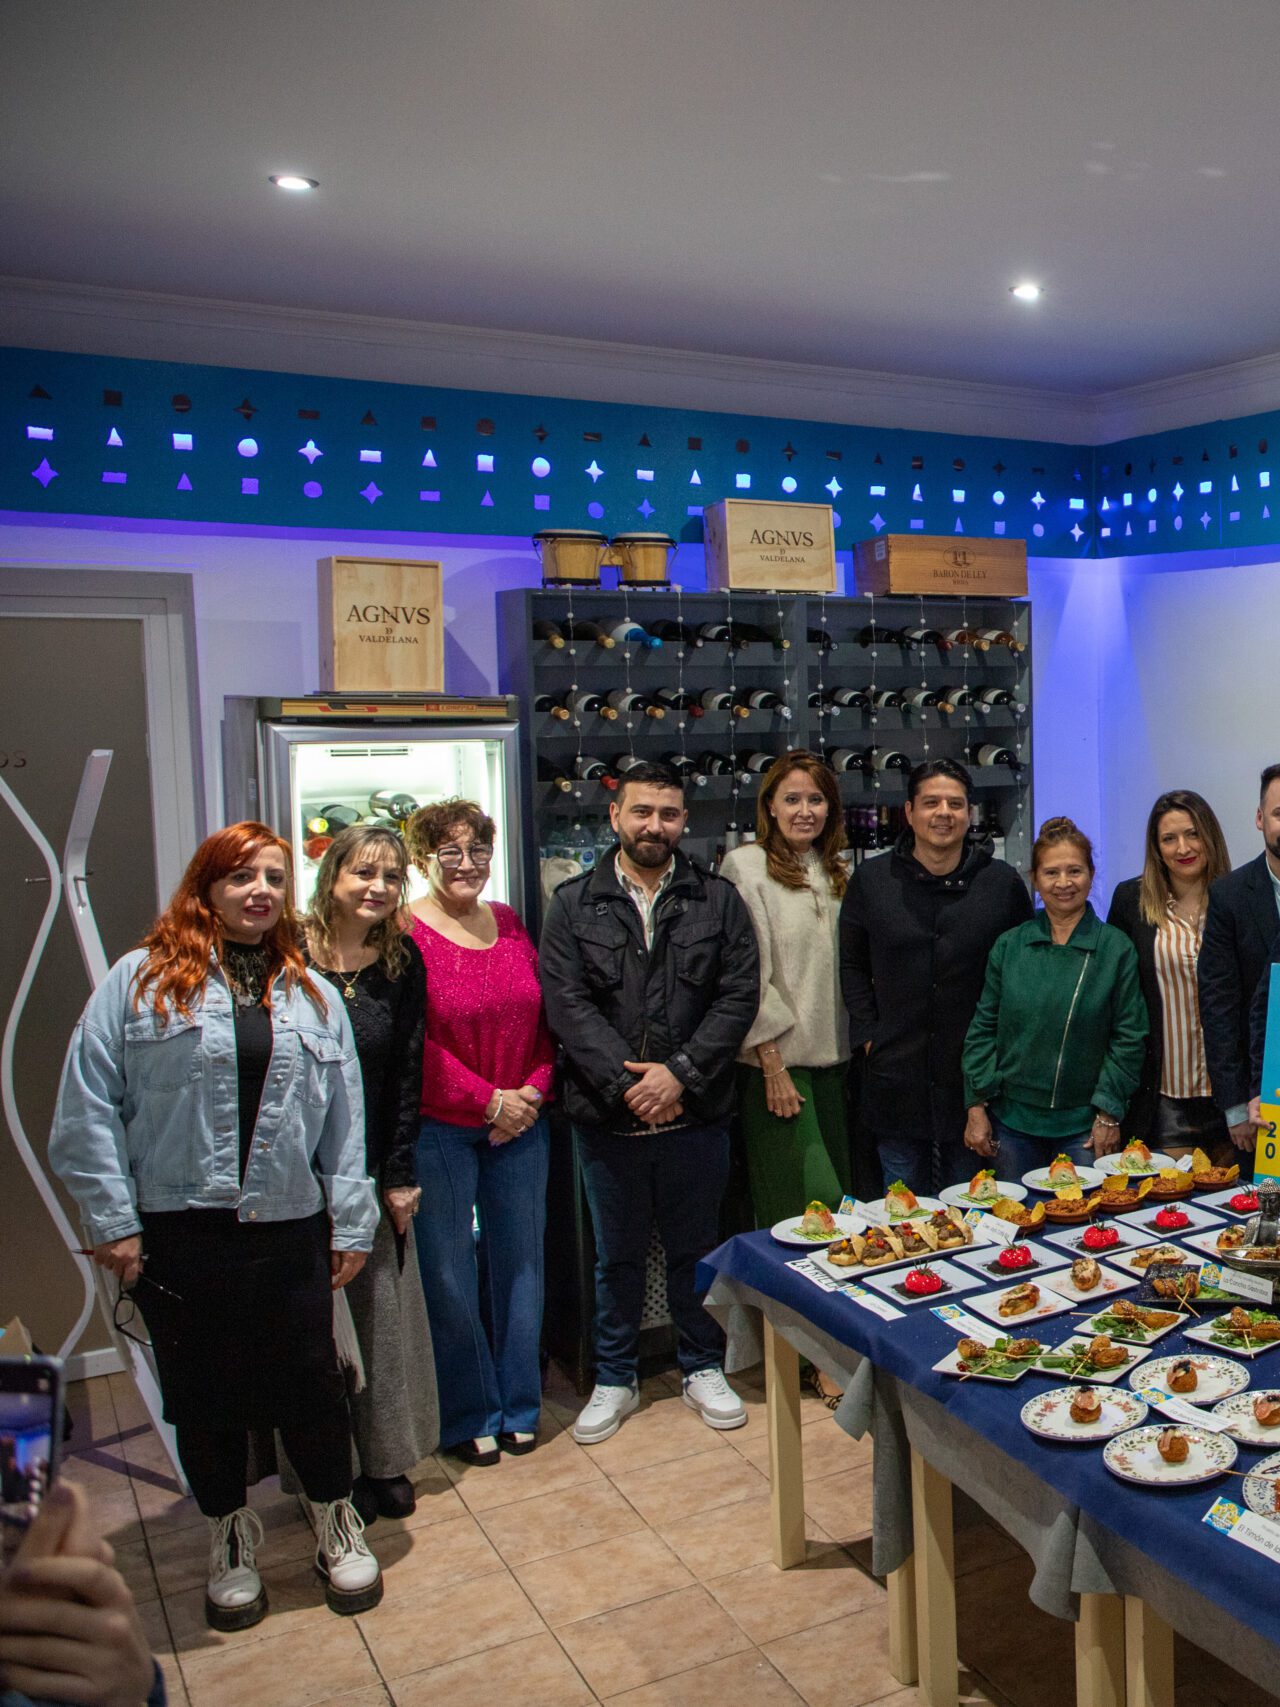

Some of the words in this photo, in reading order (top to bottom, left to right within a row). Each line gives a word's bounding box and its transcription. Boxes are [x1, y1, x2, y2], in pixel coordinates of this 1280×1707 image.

[759, 554, 806, 563] VALDELANA
[359, 635, 419, 644] VALDELANA
[1237, 1523, 1245, 1533] El
[1244, 1527, 1265, 1544] Timón
[1264, 1540, 1274, 1550] de
